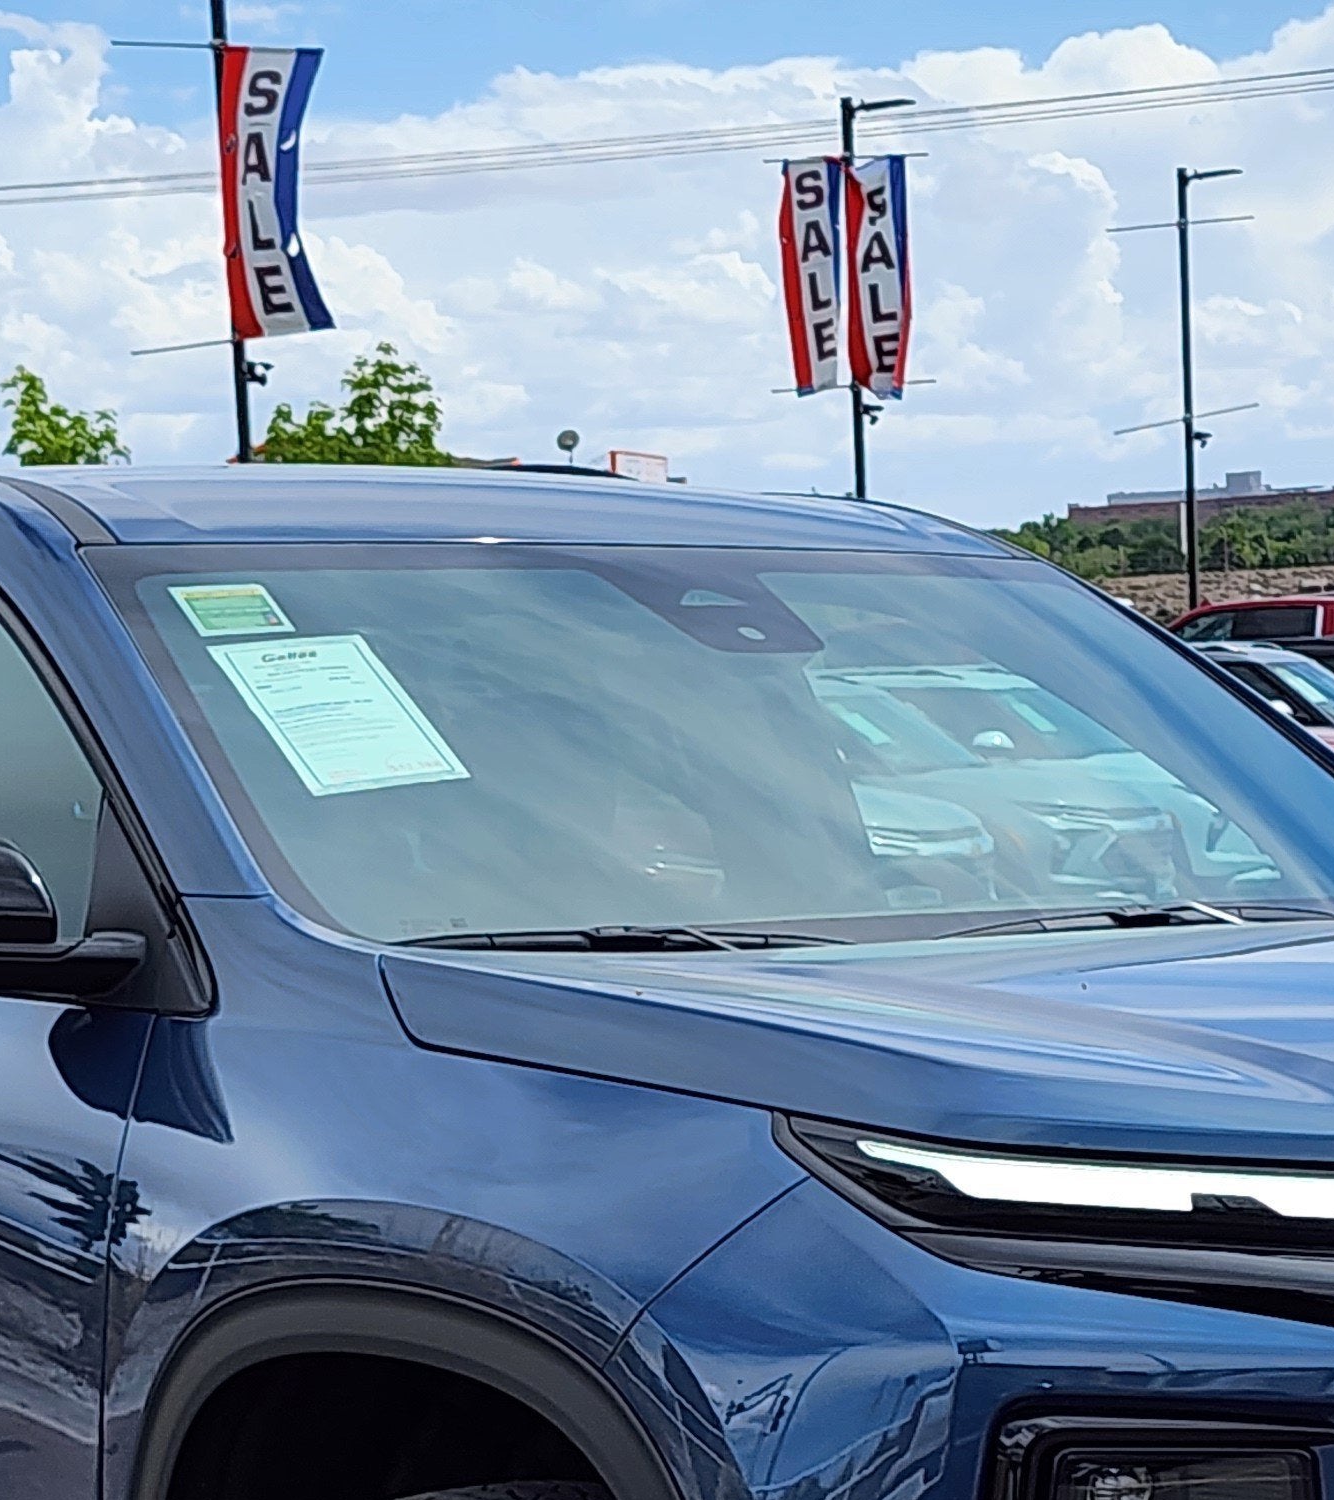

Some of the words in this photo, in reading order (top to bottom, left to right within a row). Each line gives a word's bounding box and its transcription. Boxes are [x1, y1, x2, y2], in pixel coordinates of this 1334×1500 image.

[241, 69, 295, 316] SALE
[794, 169, 837, 362] SALE
[860, 185, 900, 374] SALE
